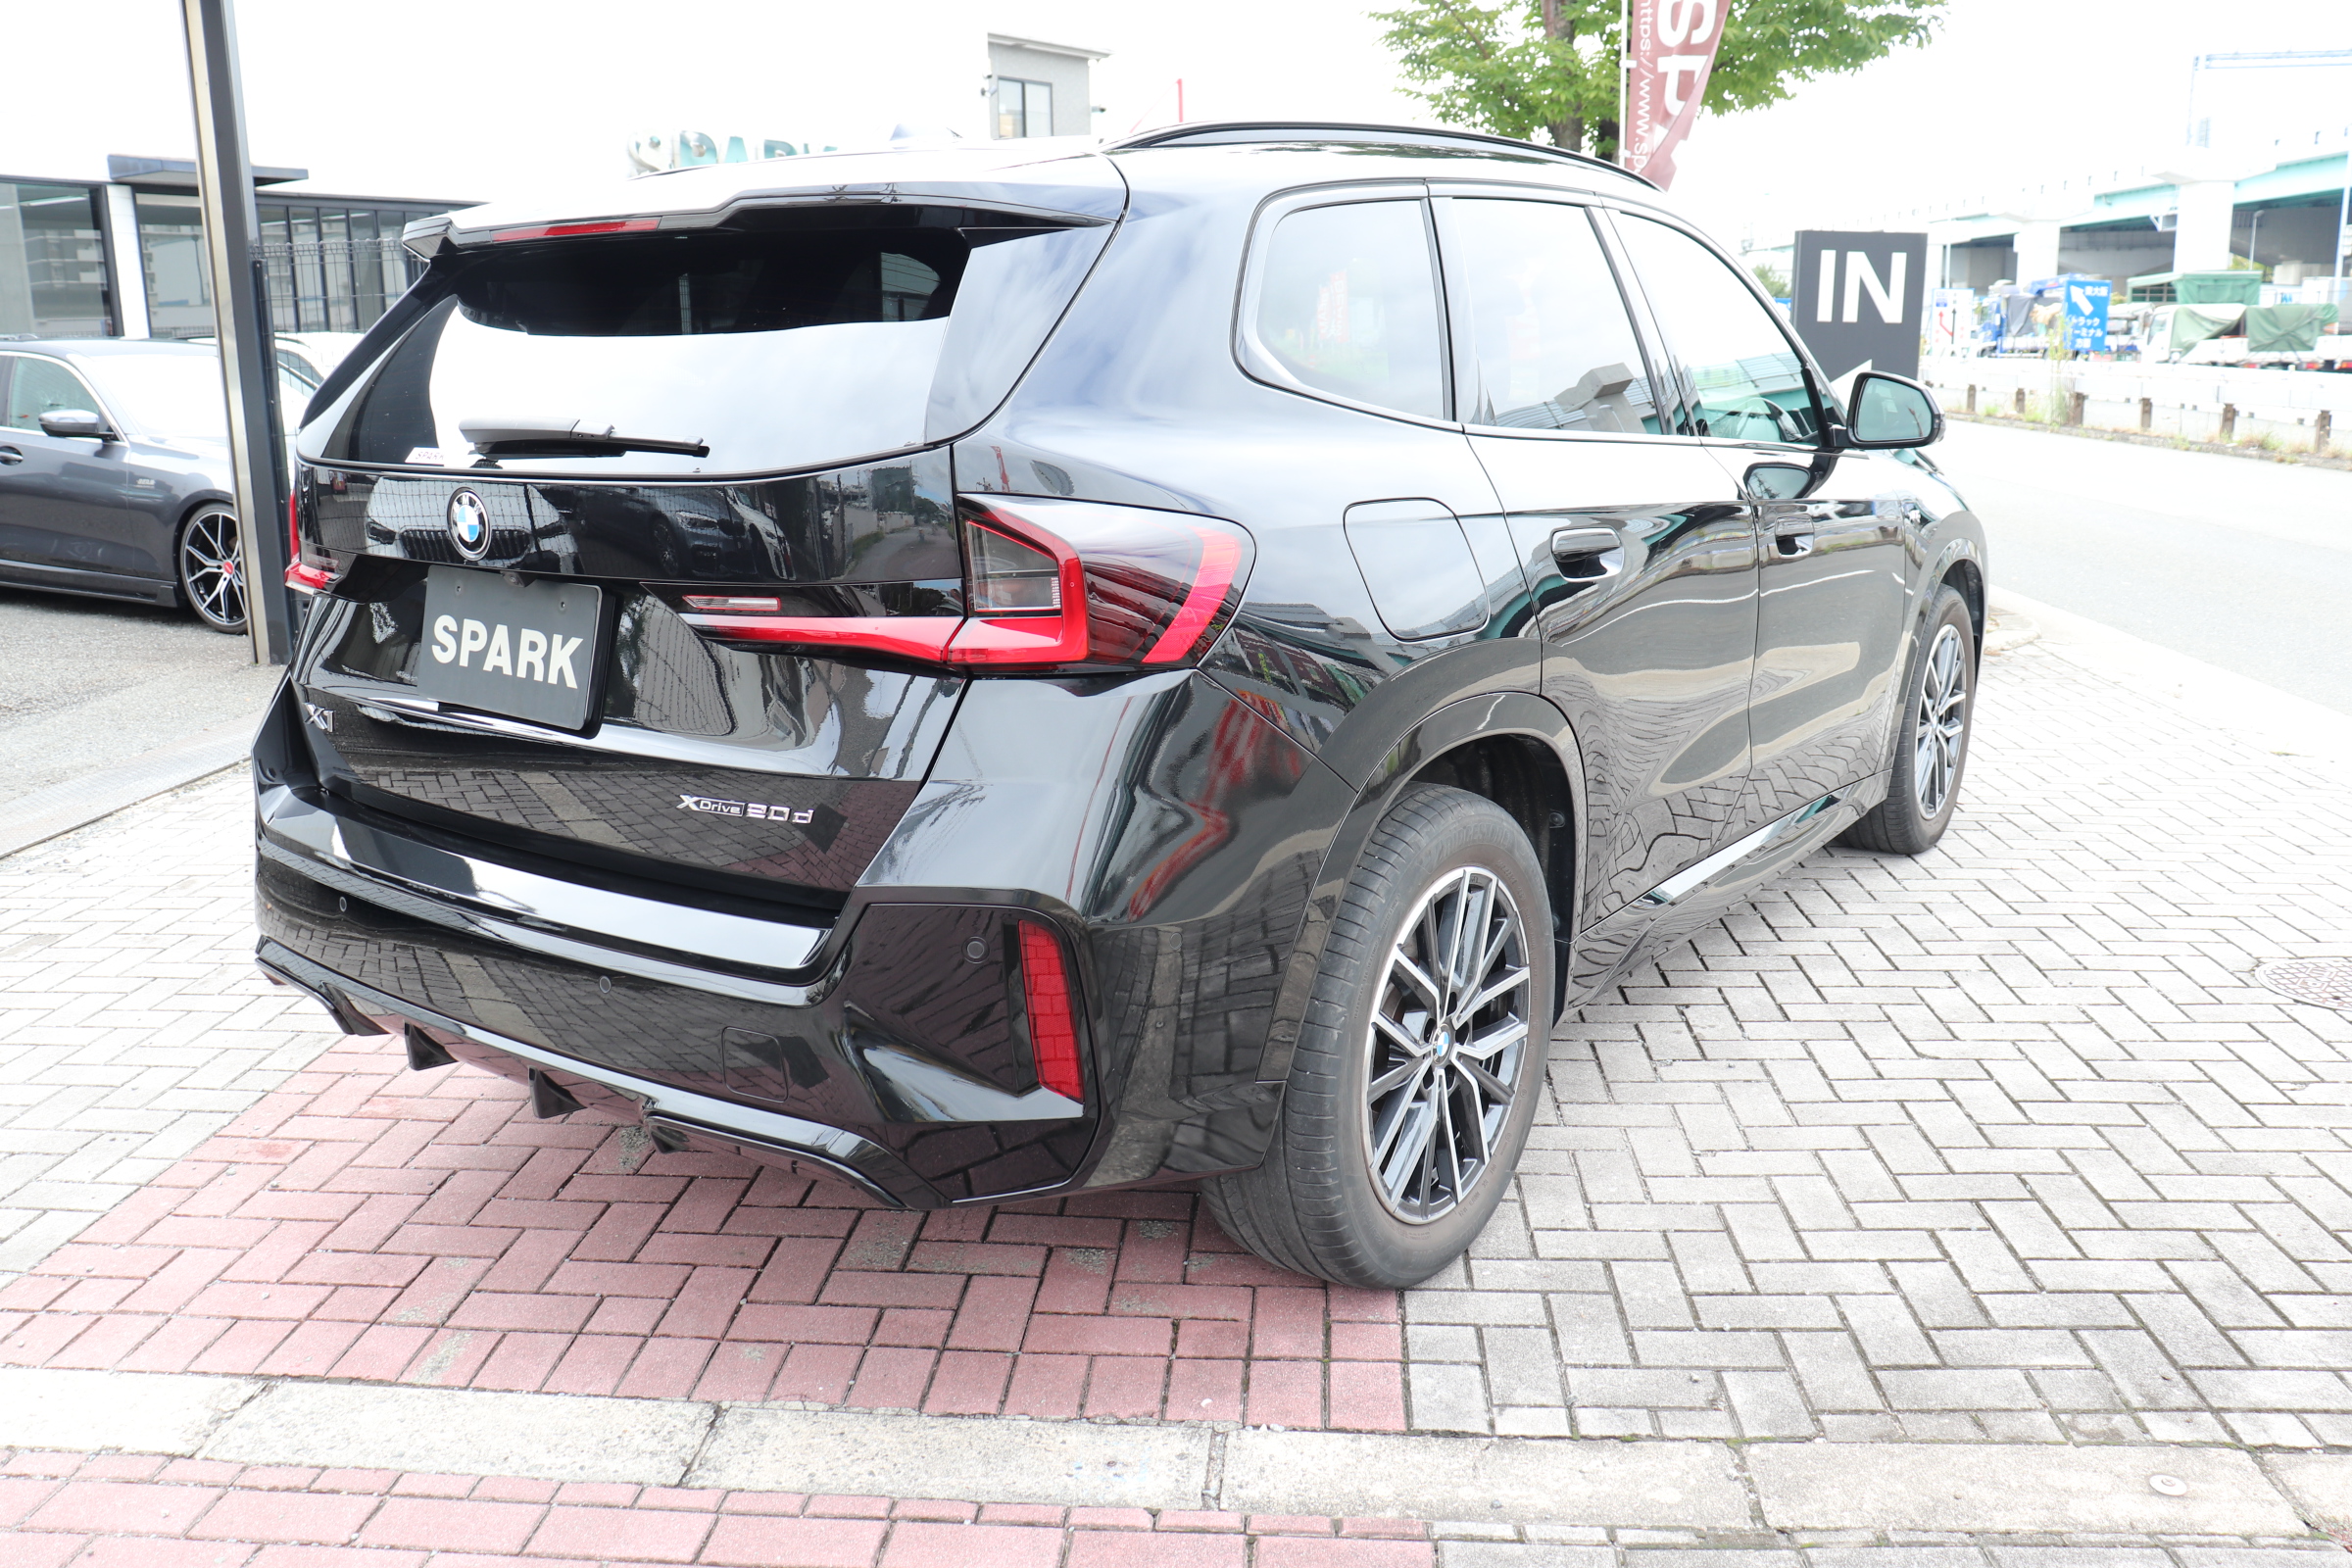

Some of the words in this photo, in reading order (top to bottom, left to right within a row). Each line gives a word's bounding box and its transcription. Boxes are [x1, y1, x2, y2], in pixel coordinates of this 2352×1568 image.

[1817, 249, 1907, 324] IN
[453, 493, 483, 515] BMW
[431, 614, 583, 689] SPARK
[303, 702, 336, 733] X1
